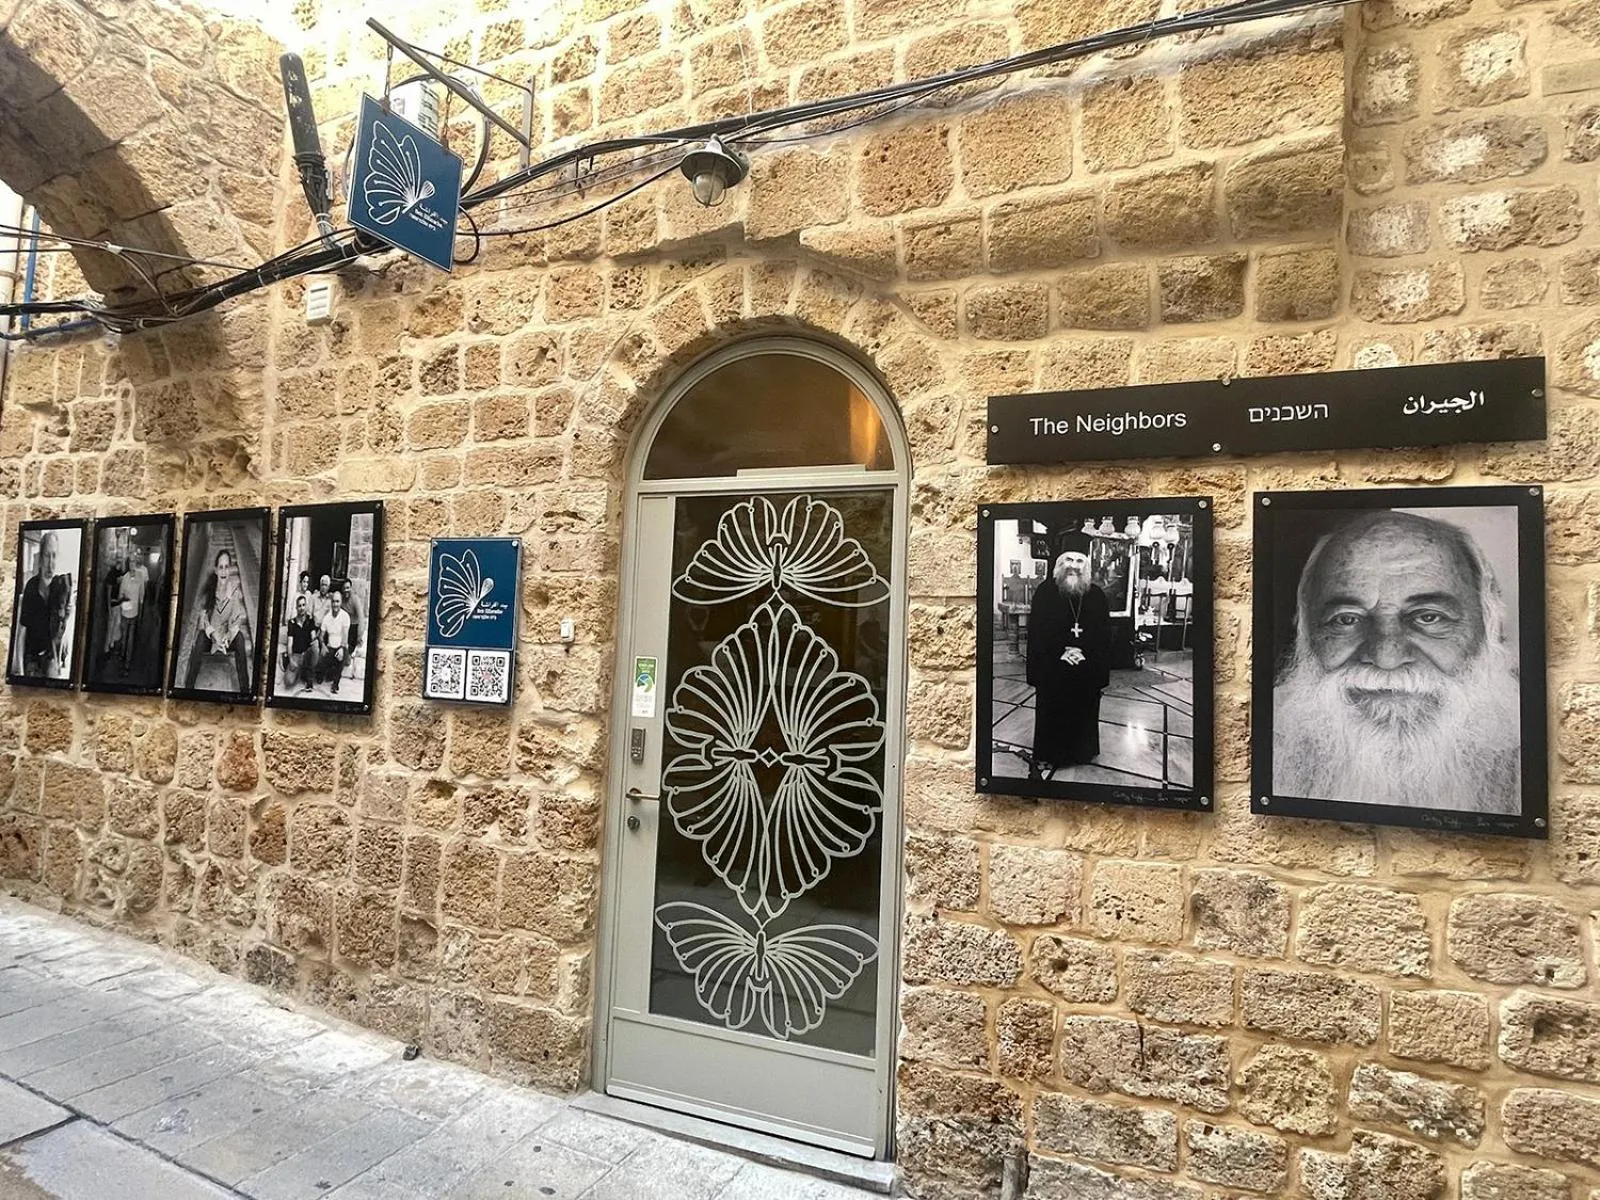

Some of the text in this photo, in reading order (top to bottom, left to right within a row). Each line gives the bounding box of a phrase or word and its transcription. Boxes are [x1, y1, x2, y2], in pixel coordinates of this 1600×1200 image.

[1248, 403, 1330, 423] השכנים
[1402, 390, 1486, 417] الجيران
[1029, 411, 1188, 436] The Neighbors
